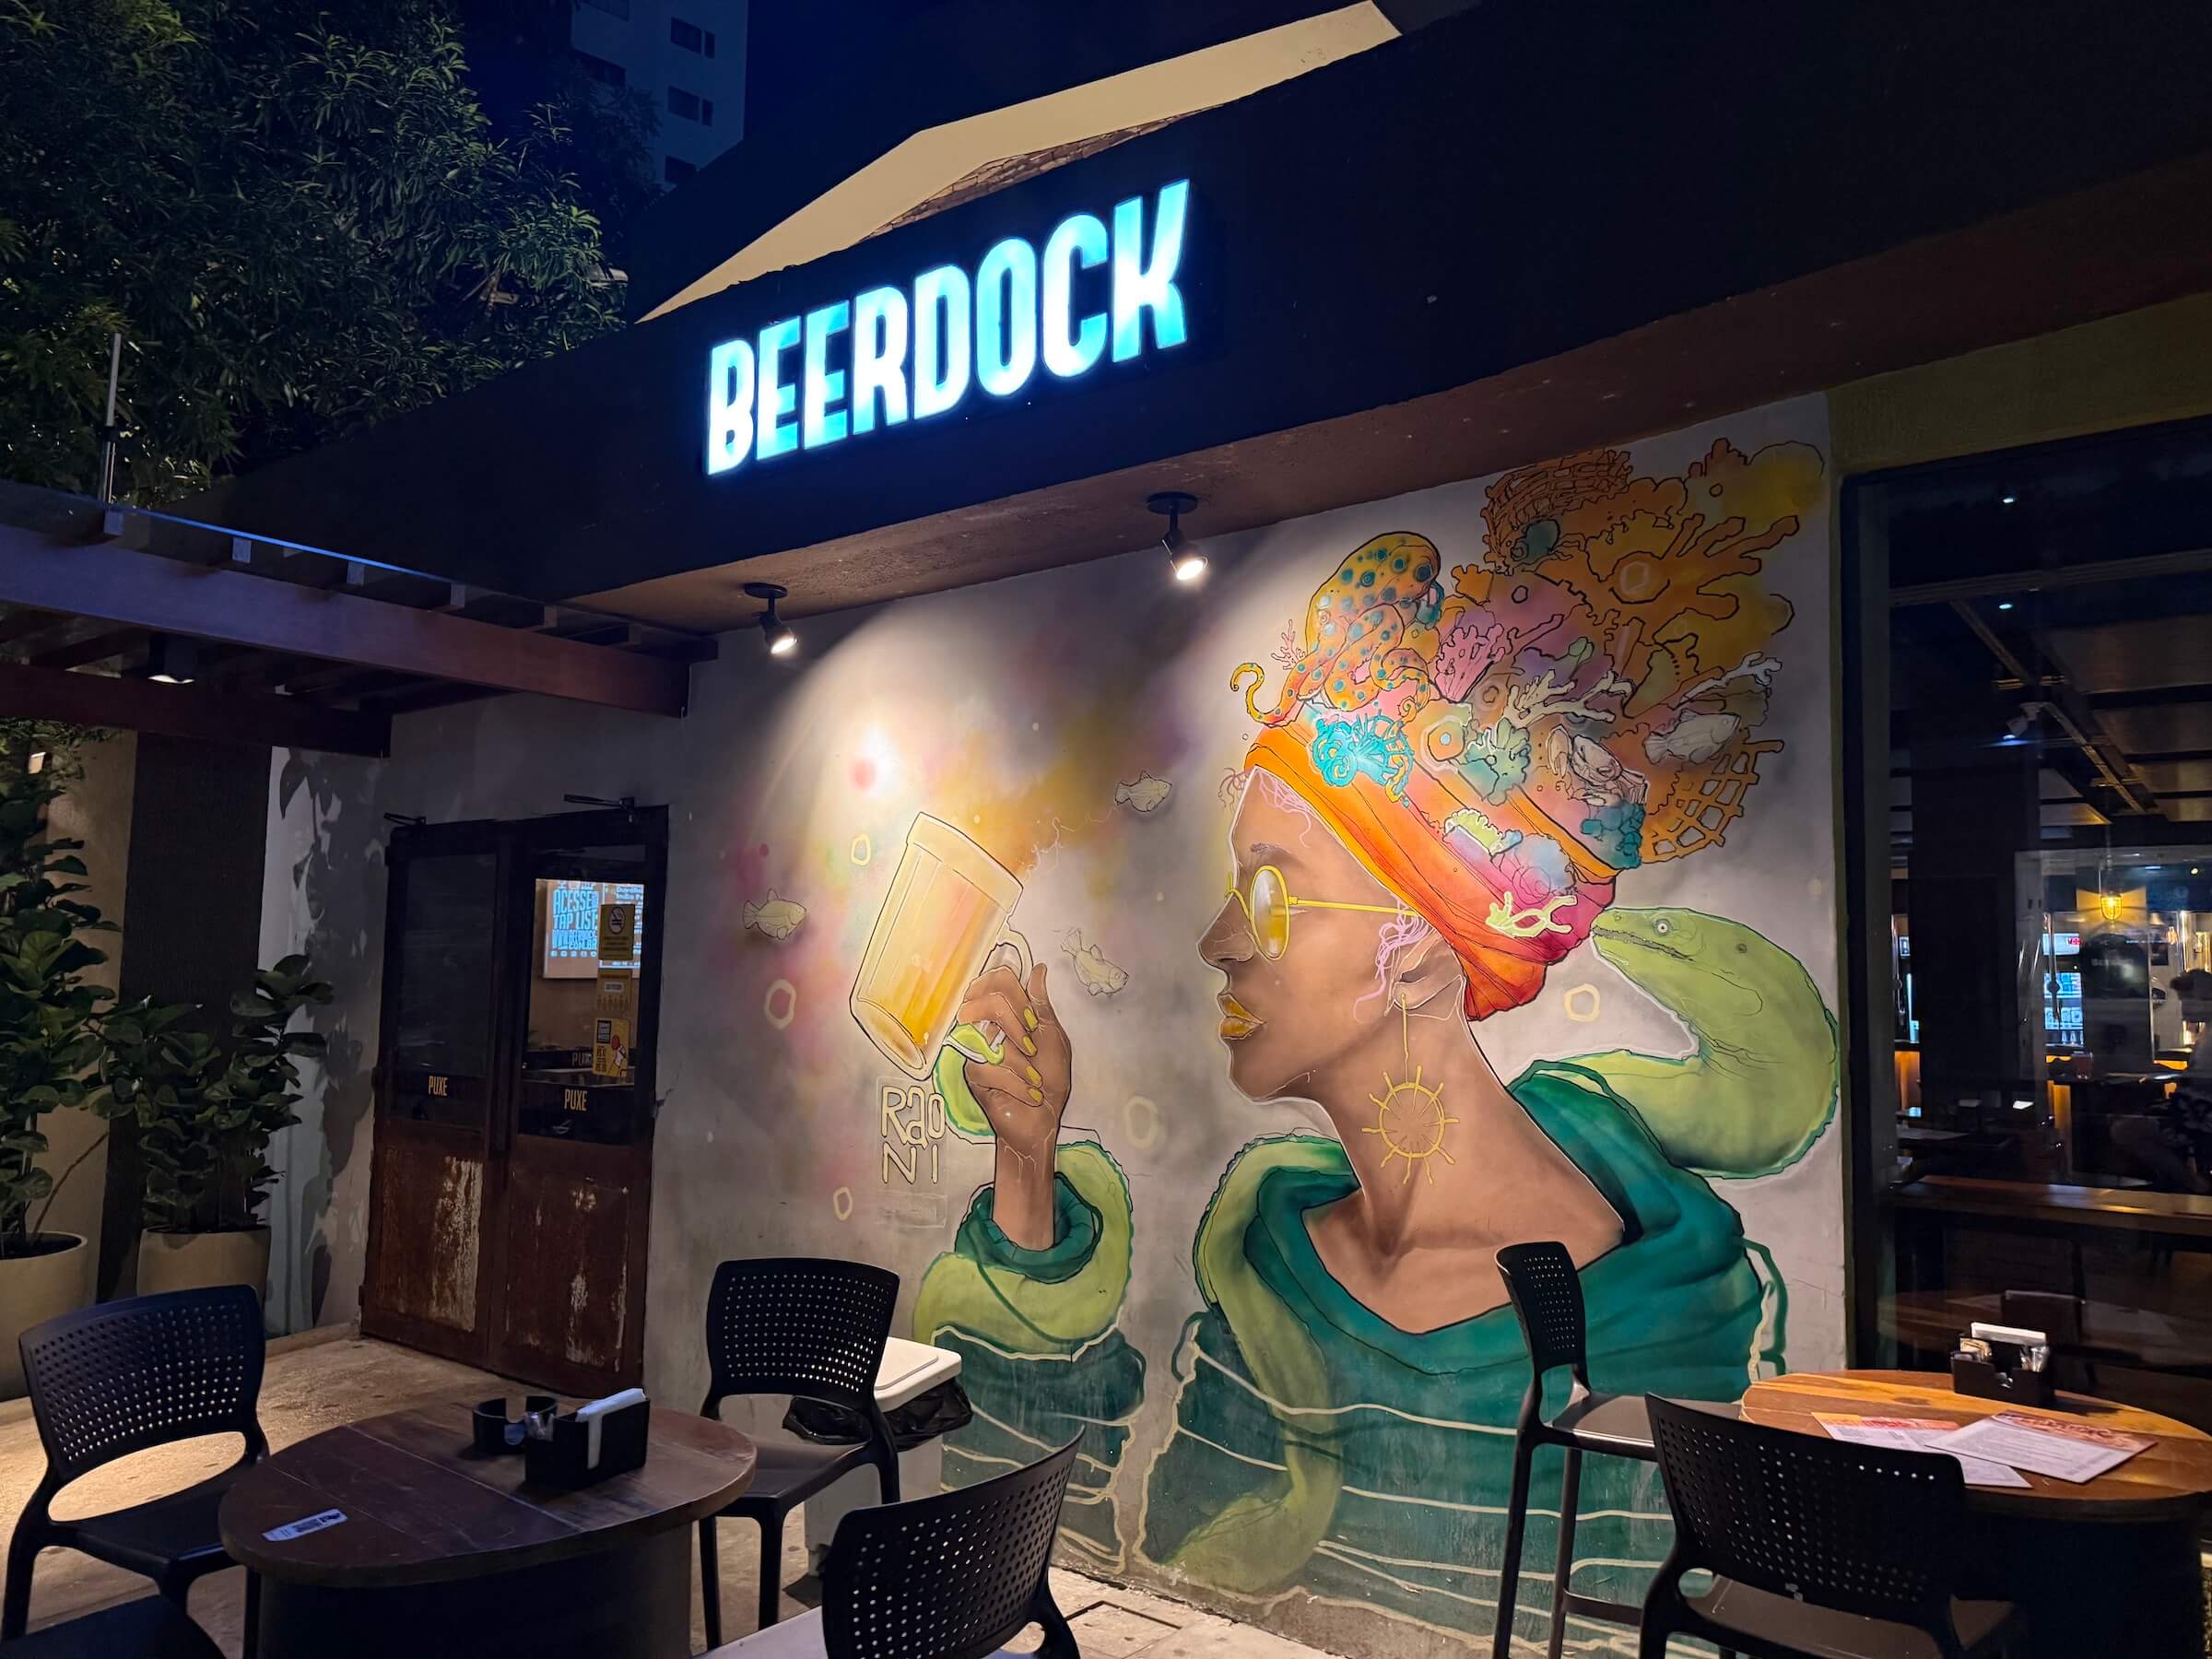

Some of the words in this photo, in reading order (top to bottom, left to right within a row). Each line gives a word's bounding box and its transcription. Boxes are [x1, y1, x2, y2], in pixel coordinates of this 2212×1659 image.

[706, 178, 1191, 477] BEERDOCK
[428, 1075, 449, 1097] PUXE
[563, 1088, 588, 1112] PUXE
